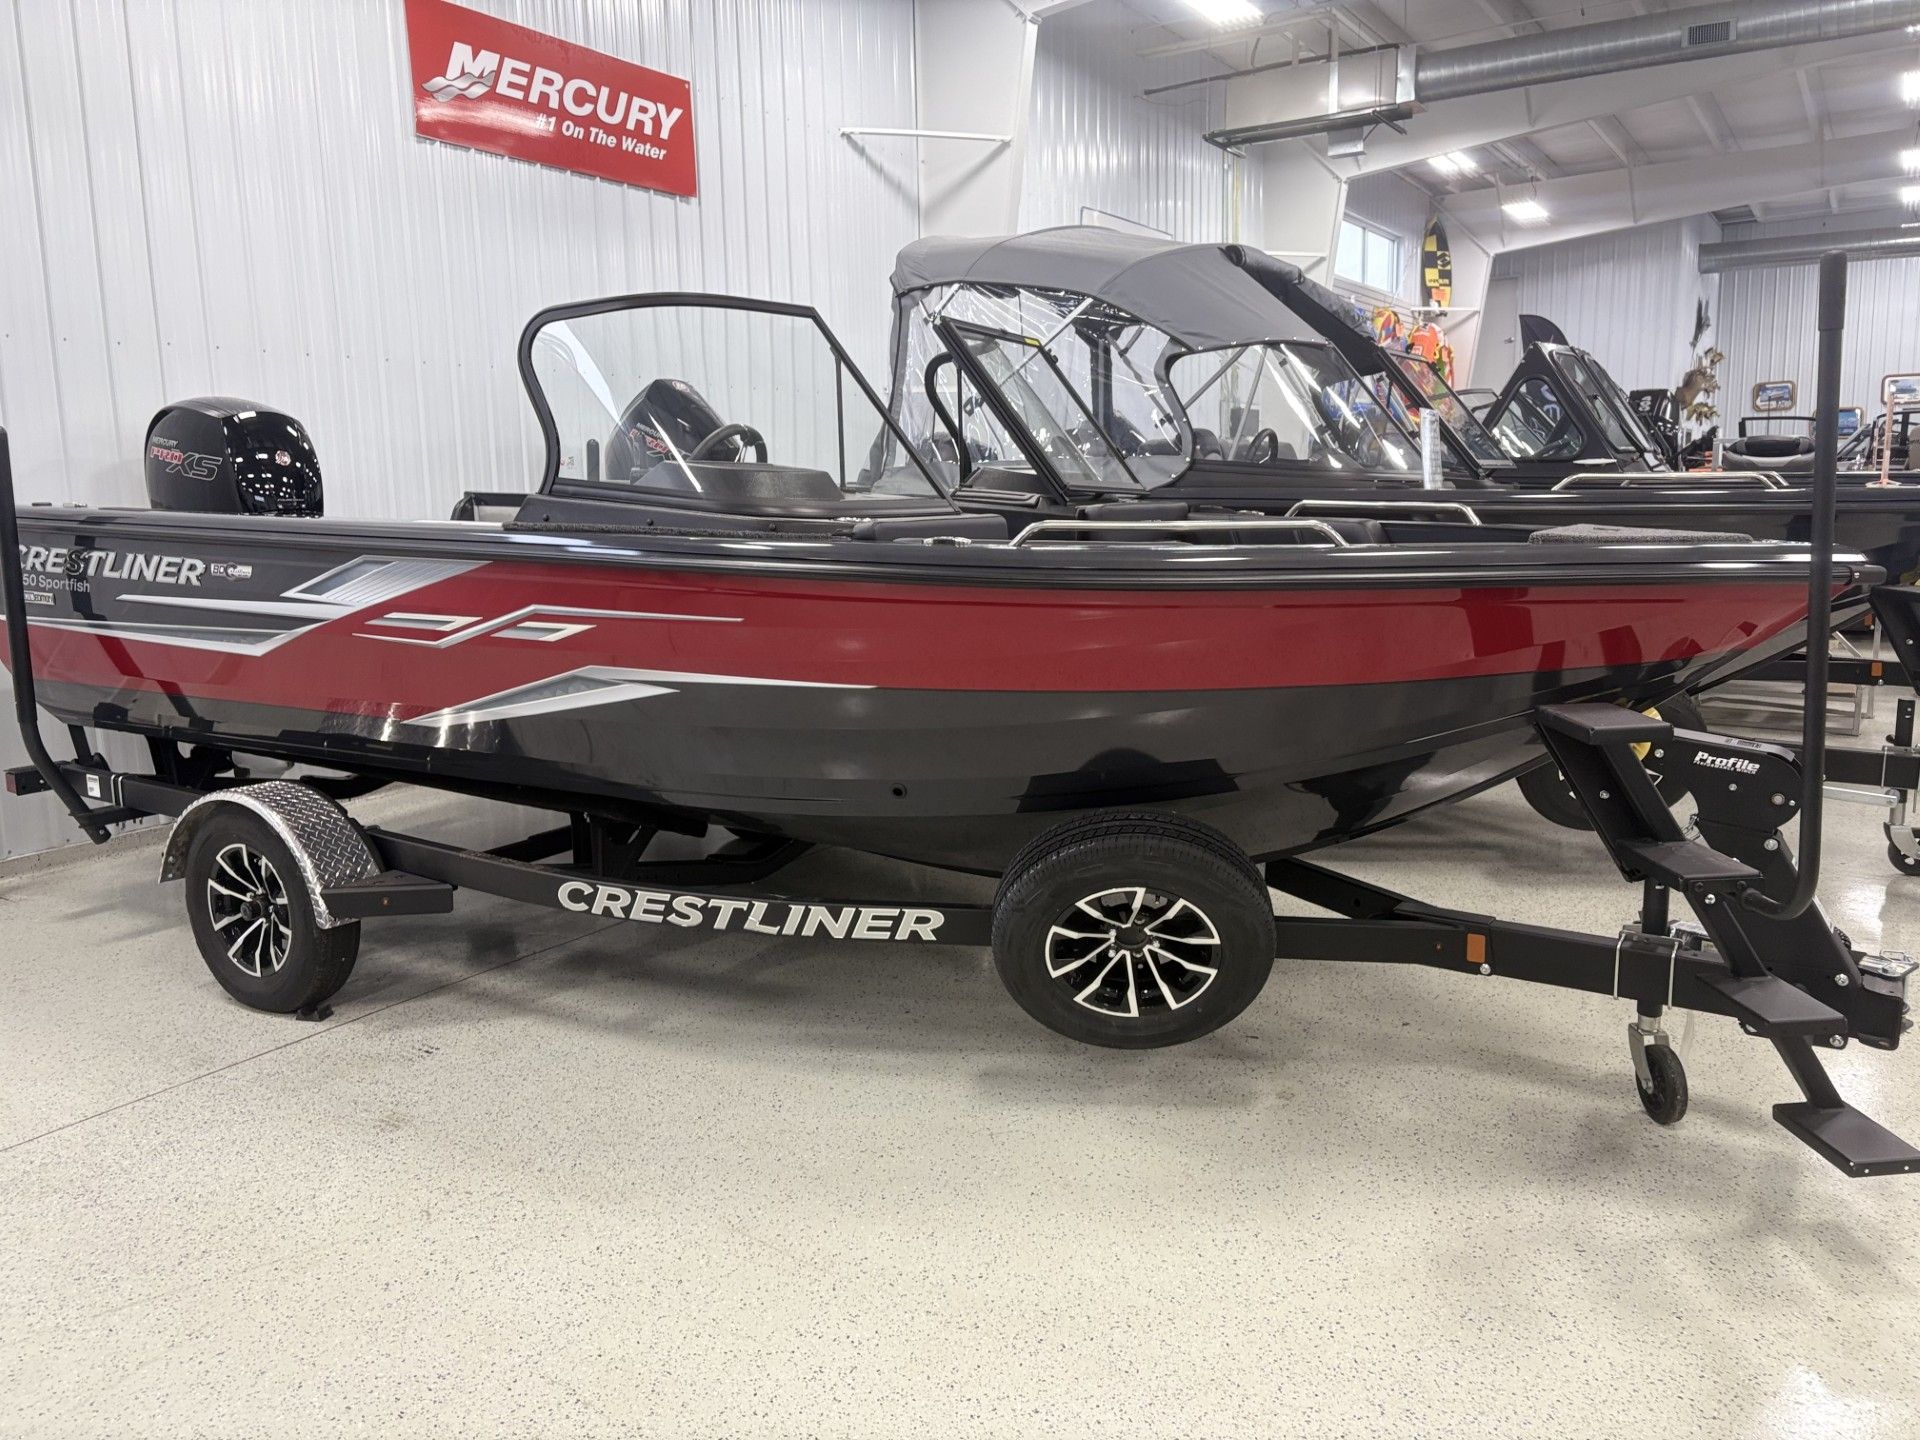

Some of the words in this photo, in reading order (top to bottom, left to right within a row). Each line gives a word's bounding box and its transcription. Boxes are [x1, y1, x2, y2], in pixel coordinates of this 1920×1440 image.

[445, 41, 683, 140] MERCURY
[535, 112, 557, 132] #1
[561, 120, 585, 140] On
[589, 126, 617, 148] The
[621, 136, 667, 160] Water
[165, 452, 224, 481] XS
[38, 575, 91, 593] Sportfish
[1693, 750, 1761, 772] Profile
[557, 881, 945, 941] CRESTLINER
